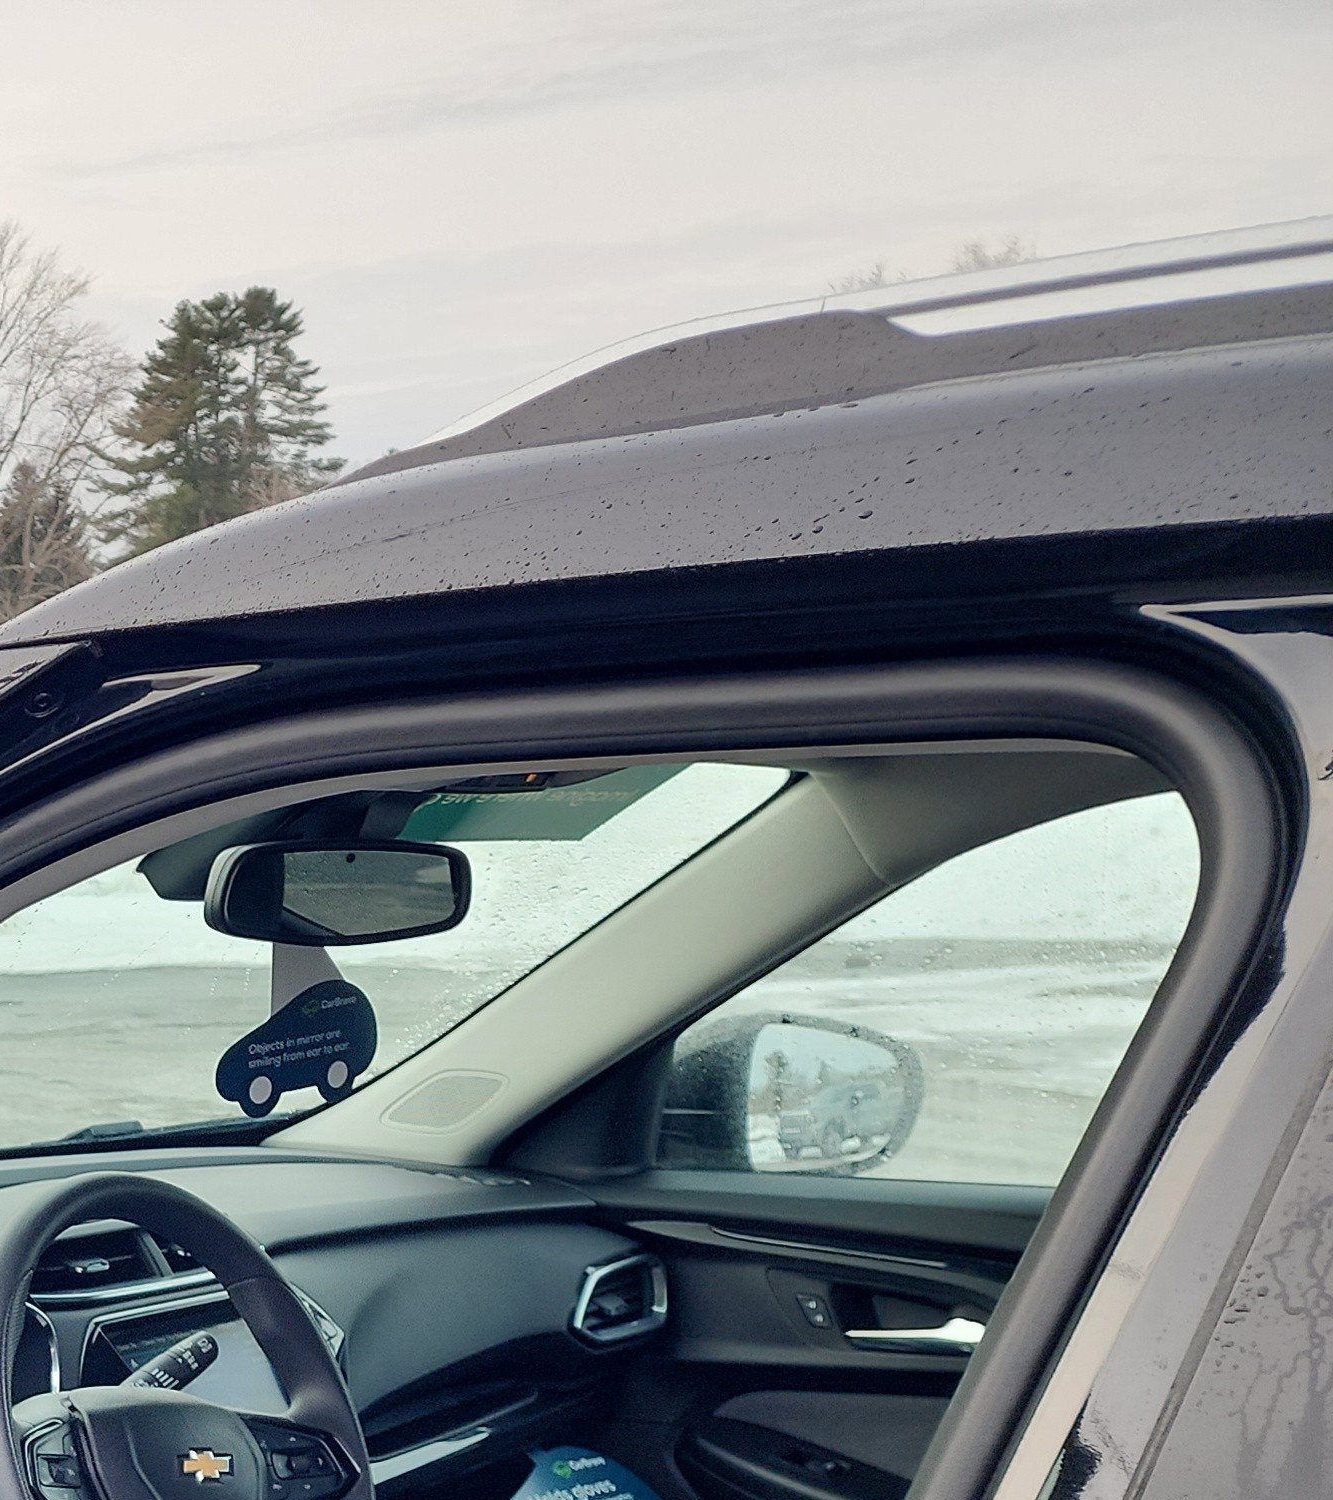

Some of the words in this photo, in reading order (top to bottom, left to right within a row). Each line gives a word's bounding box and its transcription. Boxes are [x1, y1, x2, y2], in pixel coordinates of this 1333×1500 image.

[248, 1041, 285, 1055] Objects
[286, 1037, 296, 1048] in
[296, 1033, 324, 1046] mirror
[326, 1029, 342, 1040] are
[248, 1055, 282, 1068] smiling
[283, 1050, 306, 1062] from
[306, 1046, 323, 1058] ear
[323, 1044, 334, 1055] to
